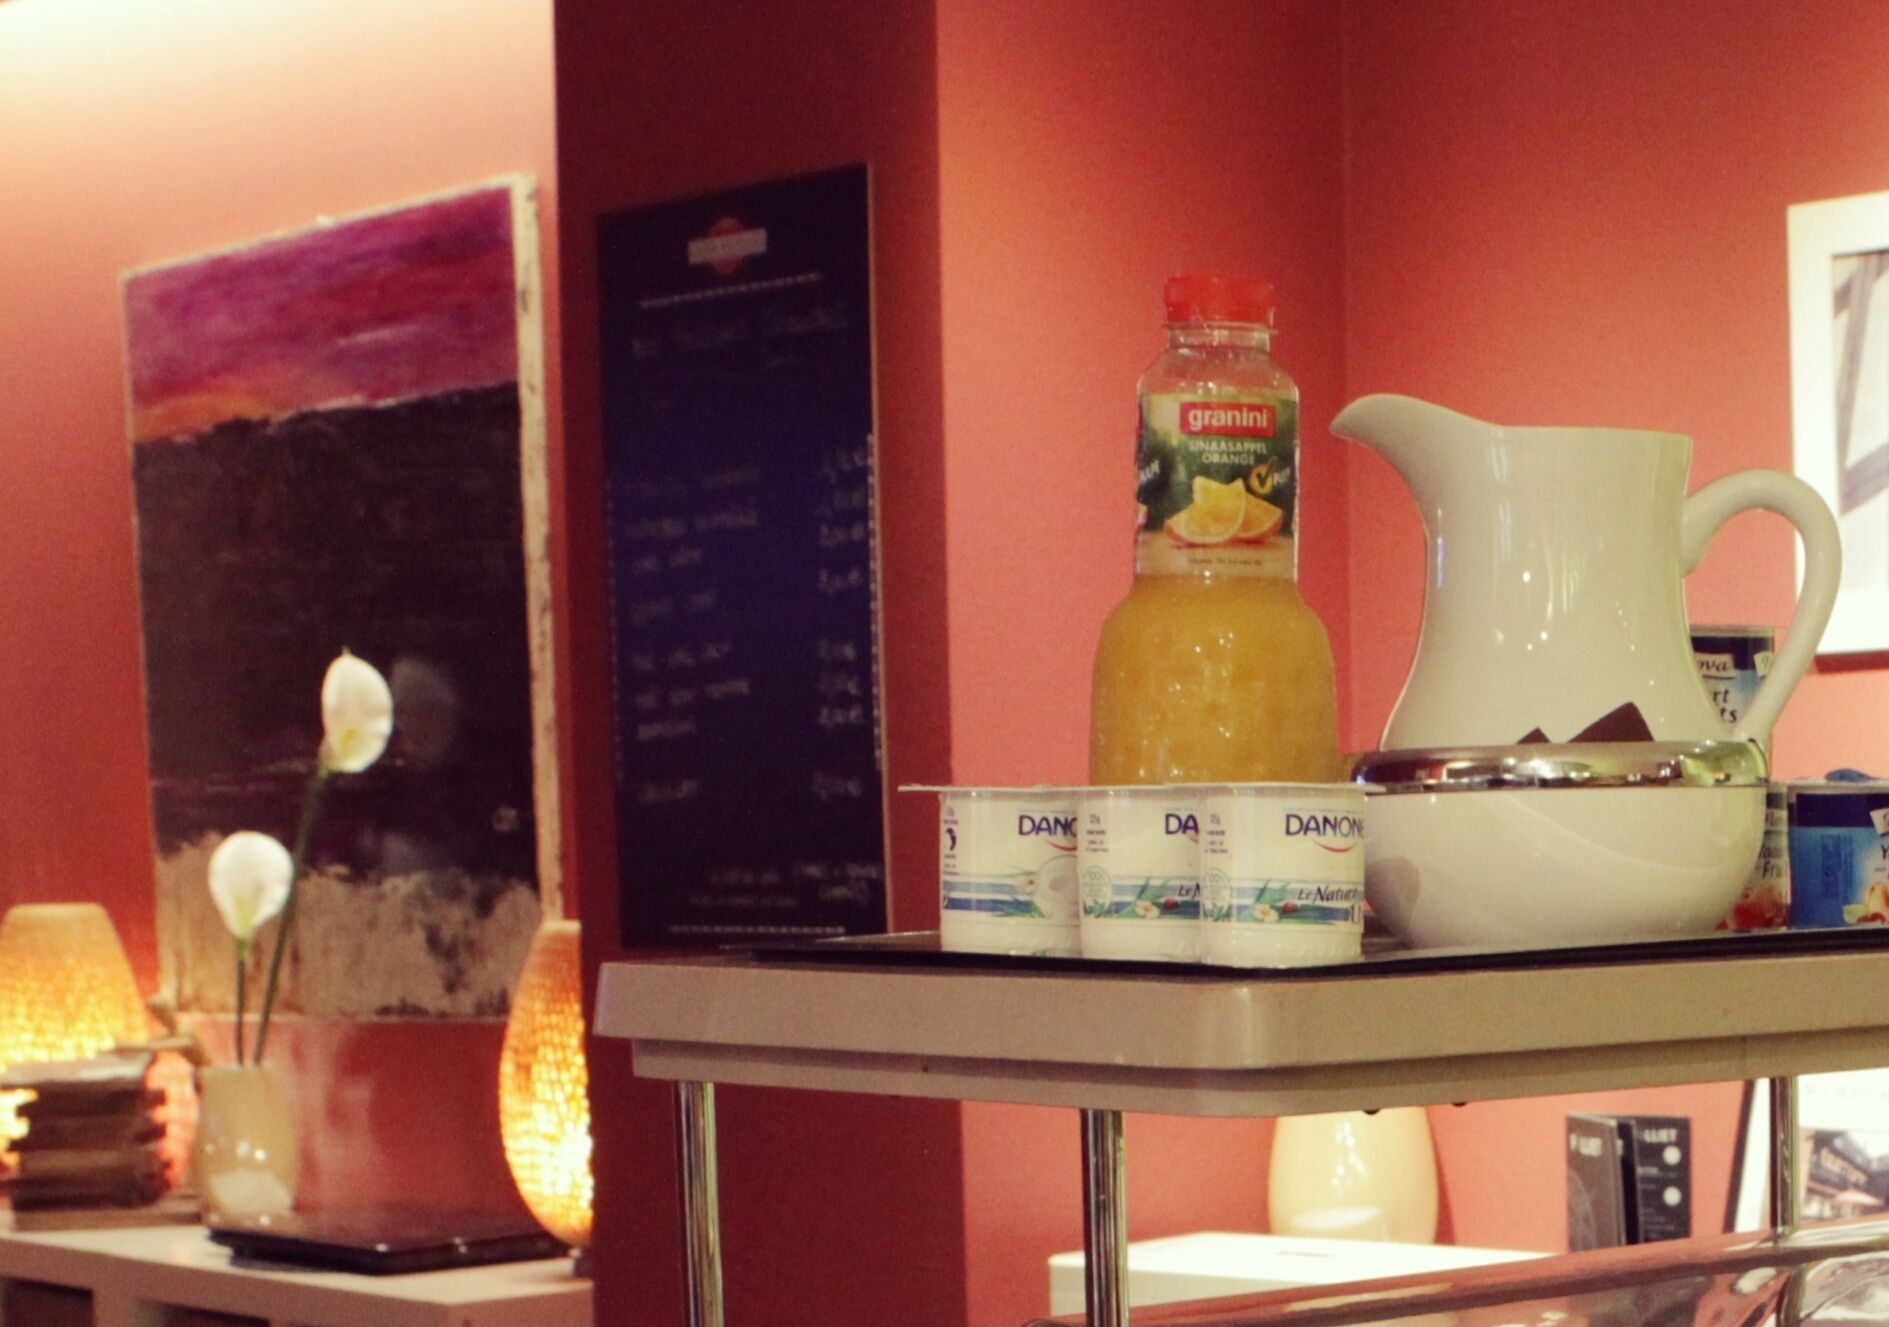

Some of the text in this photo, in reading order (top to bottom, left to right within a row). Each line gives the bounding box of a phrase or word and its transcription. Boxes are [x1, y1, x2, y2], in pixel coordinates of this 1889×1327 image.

[1188, 407, 1268, 432] granini
[1202, 453, 1255, 465] ORANGE
[1285, 813, 1364, 838] DANON
